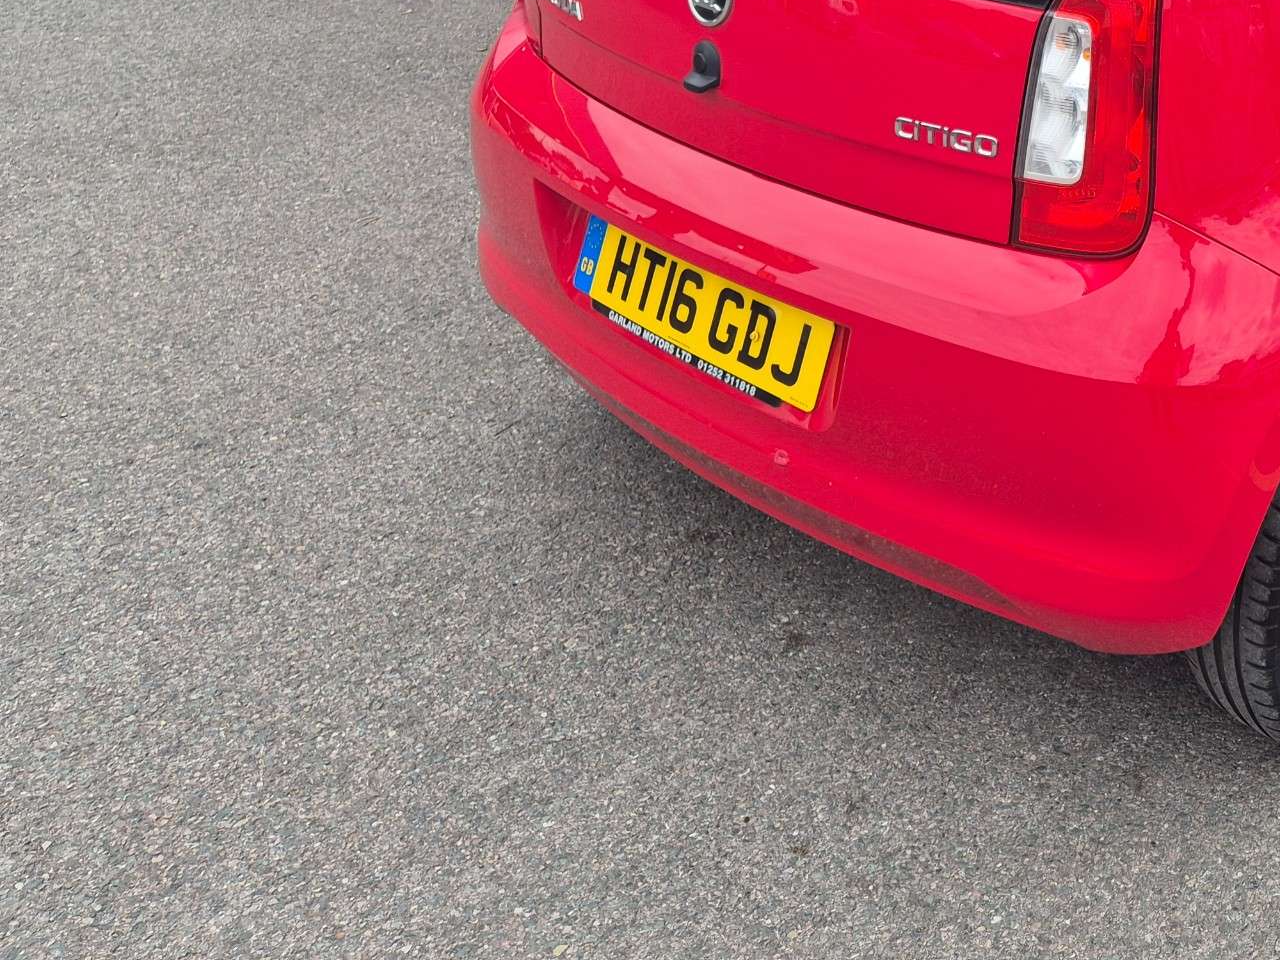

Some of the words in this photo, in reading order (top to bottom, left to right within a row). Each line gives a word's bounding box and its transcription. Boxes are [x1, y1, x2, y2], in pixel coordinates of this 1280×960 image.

[580, 256, 594, 276] GB
[606, 234, 704, 335] HT16
[708, 287, 812, 387] GDJ
[608, 310, 642, 337] GARLAND
[642, 328, 675, 354] MOTORS
[675, 346, 692, 364] LTD
[697, 360, 723, 379] 01252
[724, 374, 757, 397] 311818
